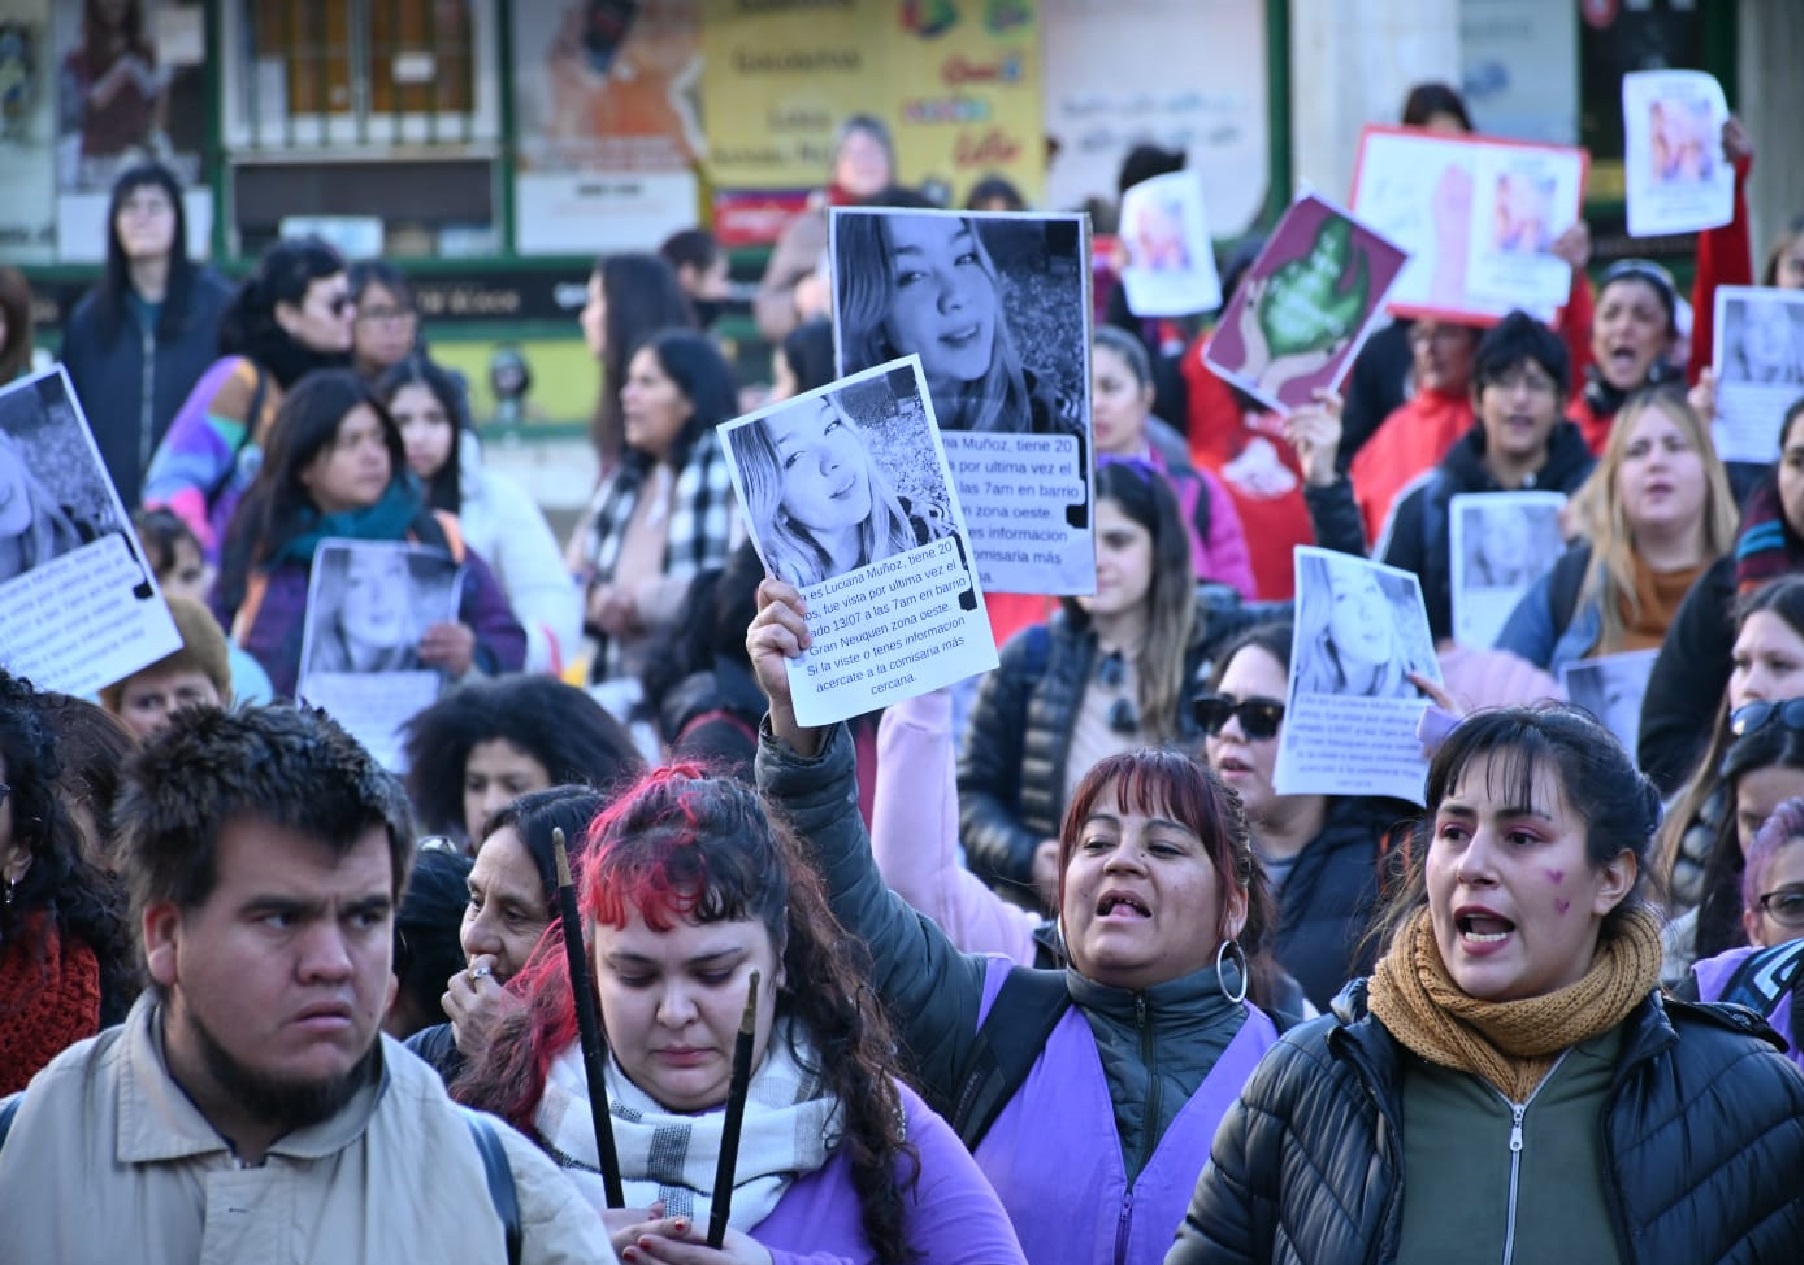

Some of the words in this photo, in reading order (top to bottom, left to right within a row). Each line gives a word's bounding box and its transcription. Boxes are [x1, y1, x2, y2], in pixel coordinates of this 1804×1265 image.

[962, 438, 1012, 452] Muñoz,
[1016, 440, 1051, 452] tiene
[1054, 440, 1073, 452] 20
[959, 460, 980, 476] por
[985, 461, 1028, 474] ultima
[1030, 464, 1055, 475] vez
[1059, 462, 1072, 475] el
[959, 482, 980, 494] las
[985, 482, 1015, 496] 7am
[1018, 486, 1035, 496] en
[1040, 484, 1080, 499] barrio
[976, 506, 1012, 518] zona
[988, 527, 1068, 542] informacion
[1032, 550, 1063, 565] más
[810, 589, 824, 600] es
[826, 574, 865, 596] Luciana
[866, 559, 908, 580] Muñoz,
[908, 549, 936, 566] tiene
[938, 540, 951, 555] 20
[824, 601, 840, 615] fue
[841, 592, 868, 608] vista
[868, 586, 886, 602] por
[888, 574, 924, 592] ultima
[924, 567, 944, 580] vez
[946, 560, 956, 572] el
[811, 624, 830, 638] ado
[833, 613, 861, 632] 13/07
[865, 608, 873, 617] a
[874, 601, 890, 615] las
[894, 596, 918, 611] 7am
[919, 589, 934, 600] en
[936, 576, 967, 596] barrio
[806, 664, 818, 677] Si
[820, 659, 831, 672] la
[834, 653, 860, 668] viste
[863, 650, 870, 660] o
[872, 639, 903, 658] tenes
[905, 616, 966, 646] informacion
[809, 641, 838, 657] Gran
[840, 623, 890, 648] Neuquen
[891, 614, 918, 631] zona
[816, 671, 864, 694] acercate
[866, 668, 874, 678] a
[876, 664, 886, 676] la
[888, 646, 941, 670] comisaria
[942, 636, 965, 652] más
[871, 672, 917, 695] cercana.
